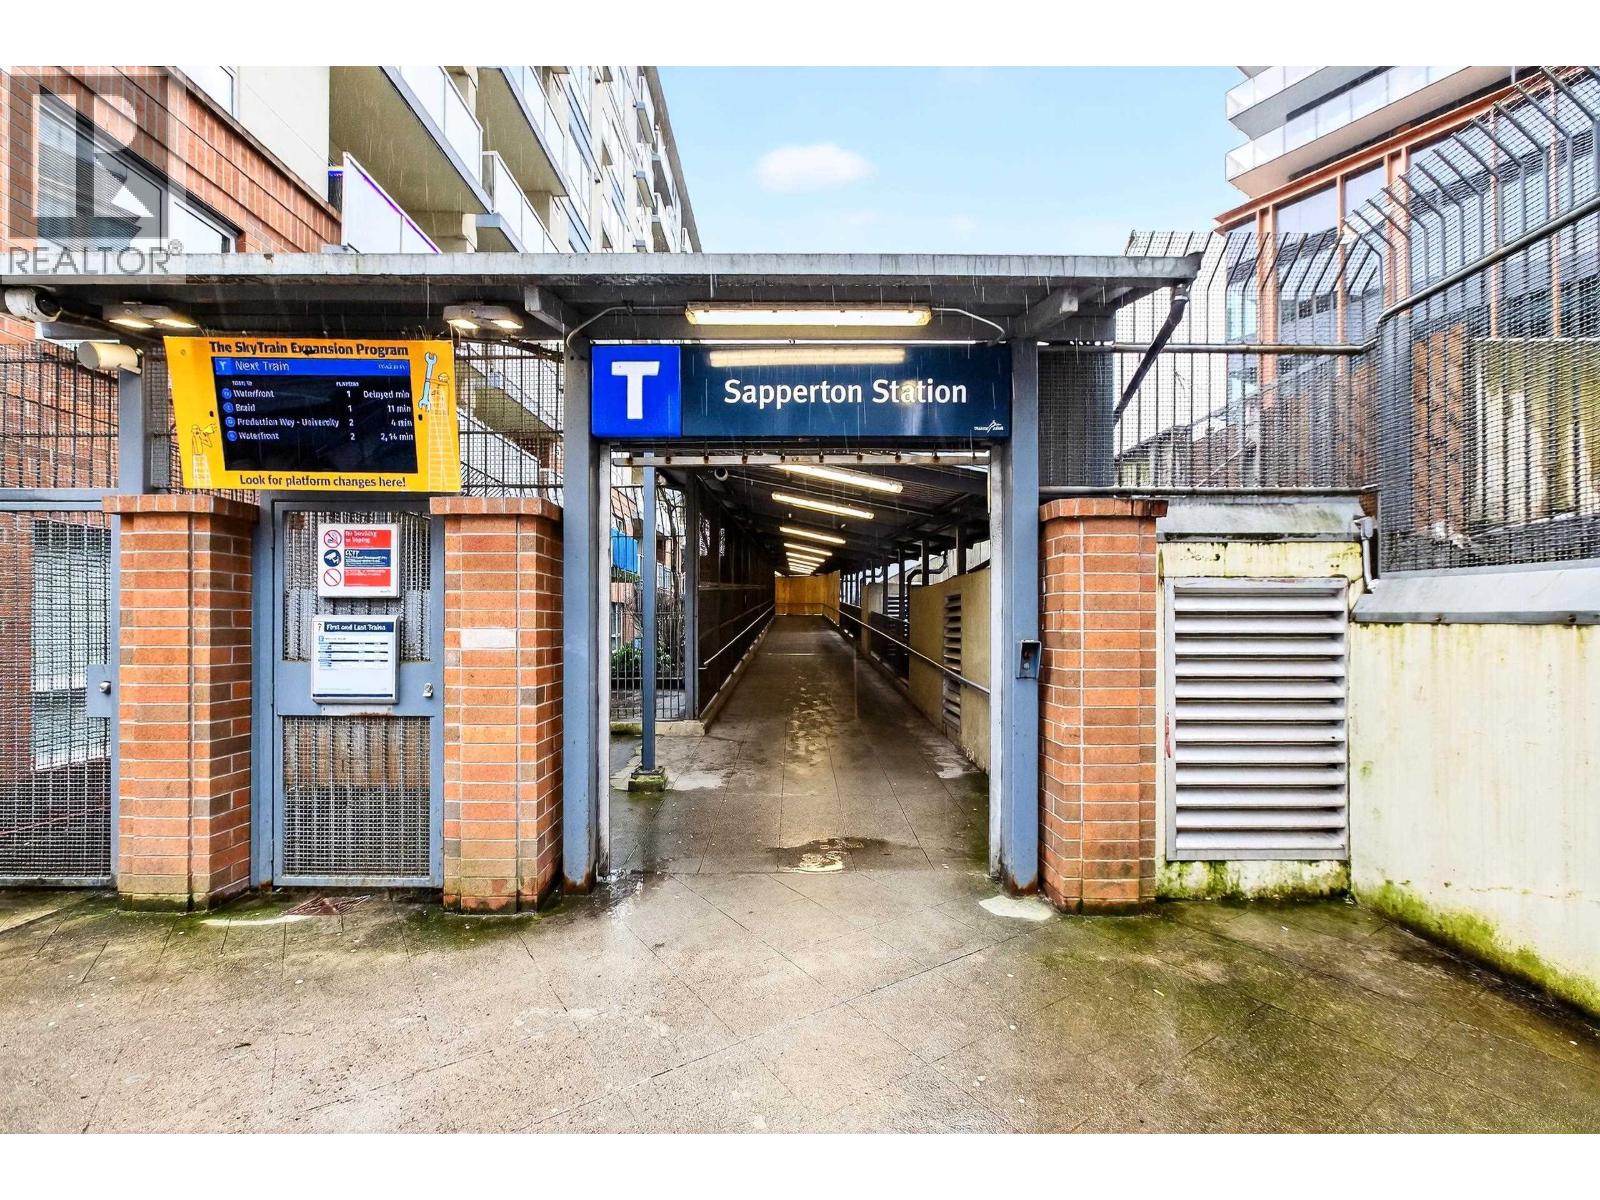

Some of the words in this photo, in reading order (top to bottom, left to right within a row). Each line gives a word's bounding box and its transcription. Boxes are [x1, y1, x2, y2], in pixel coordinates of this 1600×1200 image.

[209, 341, 232, 353] The
[235, 341, 288, 355] SkyTrain
[291, 342, 353, 356] Expansion
[356, 343, 409, 357] Program
[235, 360, 260, 371] Next
[263, 361, 290, 372] Train
[363, 390, 394, 400] Delayed
[395, 390, 410, 398] min
[611, 361, 660, 420] T
[724, 379, 863, 409] Sapperton
[871, 379, 968, 404] Station
[387, 404, 395, 413] 11
[396, 404, 411, 413] min
[349, 419, 354, 427] 2
[350, 432, 356, 441] 2
[399, 432, 414, 441] min
[239, 474, 266, 485] Look
[268, 475, 283, 486] for
[286, 476, 331, 488] platform
[333, 477, 376, 489] changes
[378, 477, 406, 488] here!
